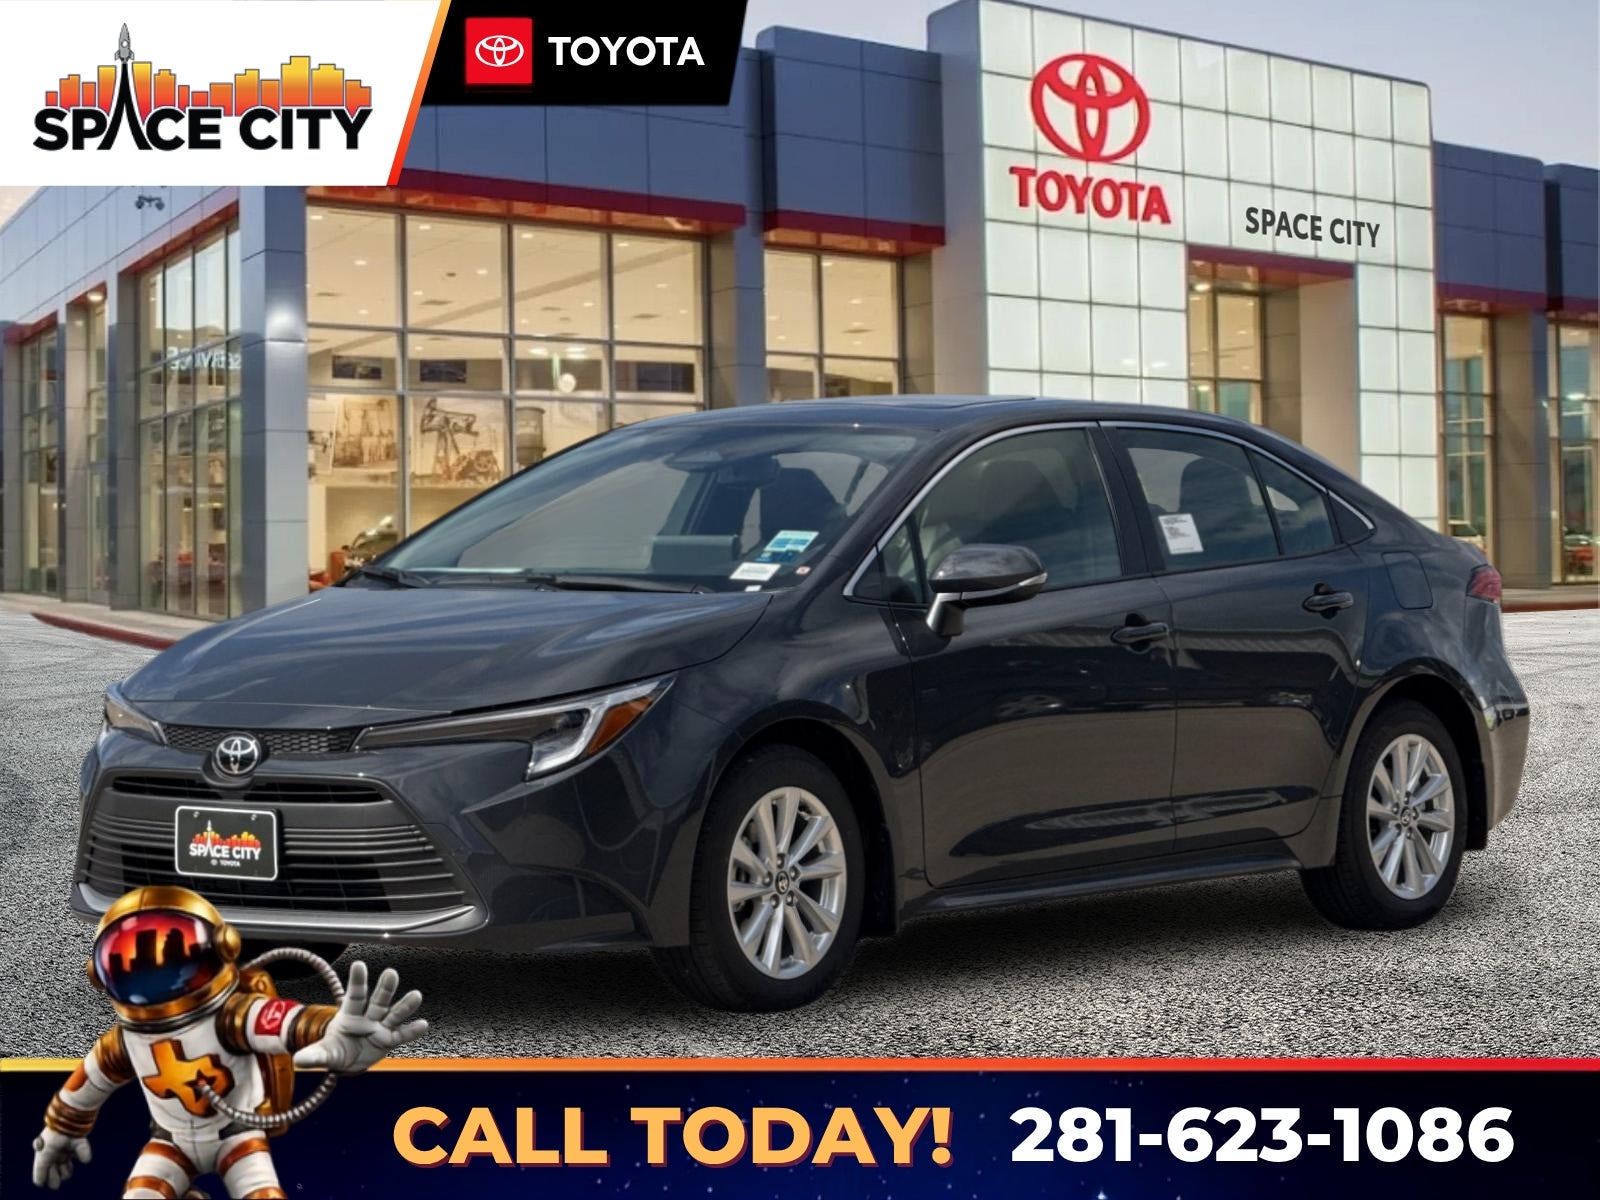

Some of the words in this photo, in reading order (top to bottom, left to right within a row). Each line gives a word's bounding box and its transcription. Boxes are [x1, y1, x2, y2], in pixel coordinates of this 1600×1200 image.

[1009, 166, 1171, 223] TOYOTA
[1245, 206, 1322, 242] SPACE
[1329, 218, 1381, 248] CITY
[189, 842, 230, 858] SPACE
[232, 846, 261, 860] CITY
